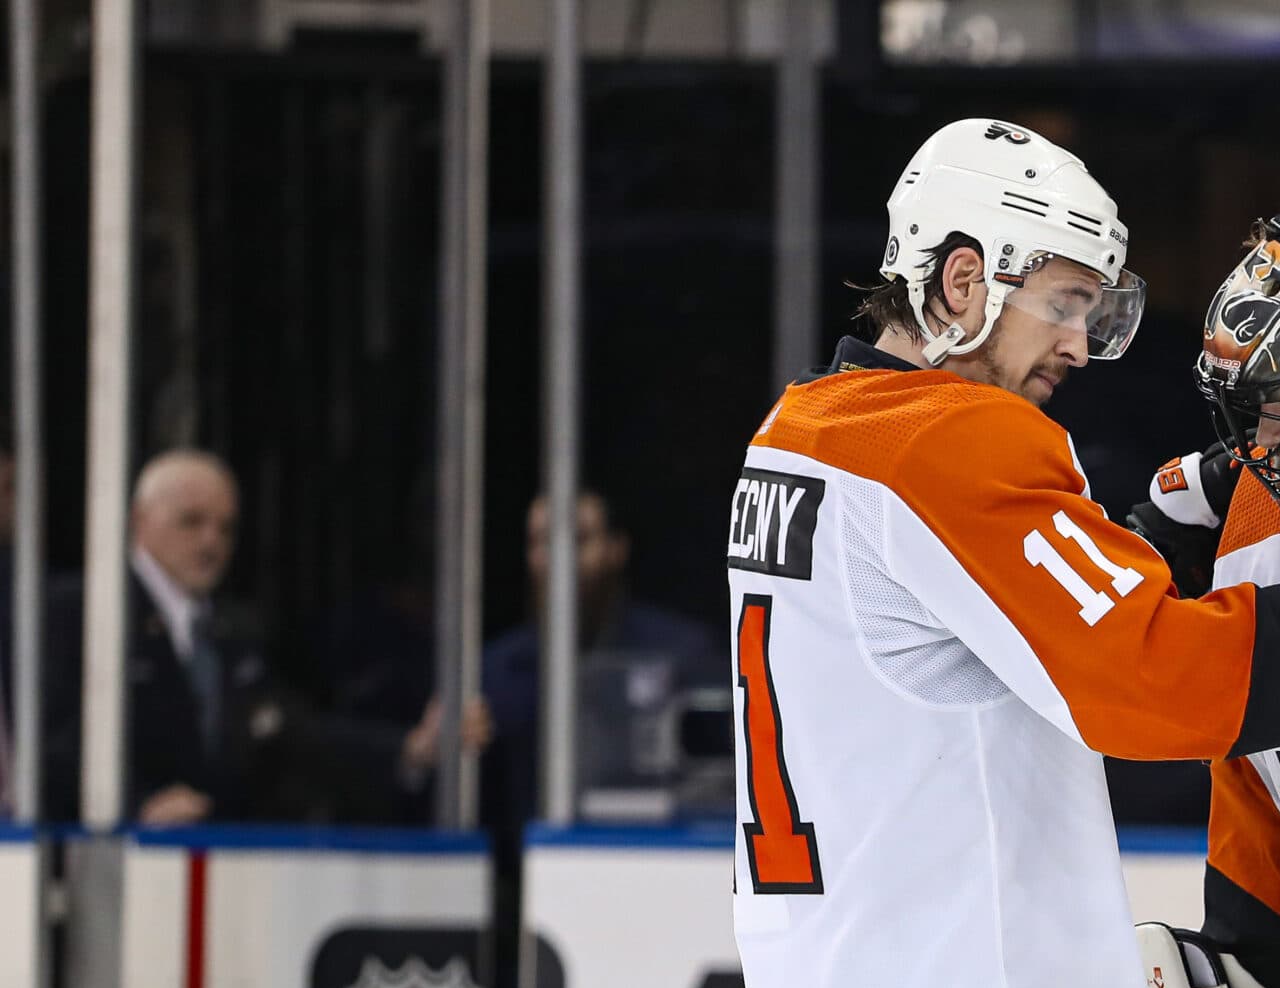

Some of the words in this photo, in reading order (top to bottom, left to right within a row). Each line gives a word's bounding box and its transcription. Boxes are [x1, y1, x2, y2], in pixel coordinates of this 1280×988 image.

[727, 478, 806, 565] ECNY
[1023, 509, 1145, 627] 11
[739, 594, 825, 895] 1
